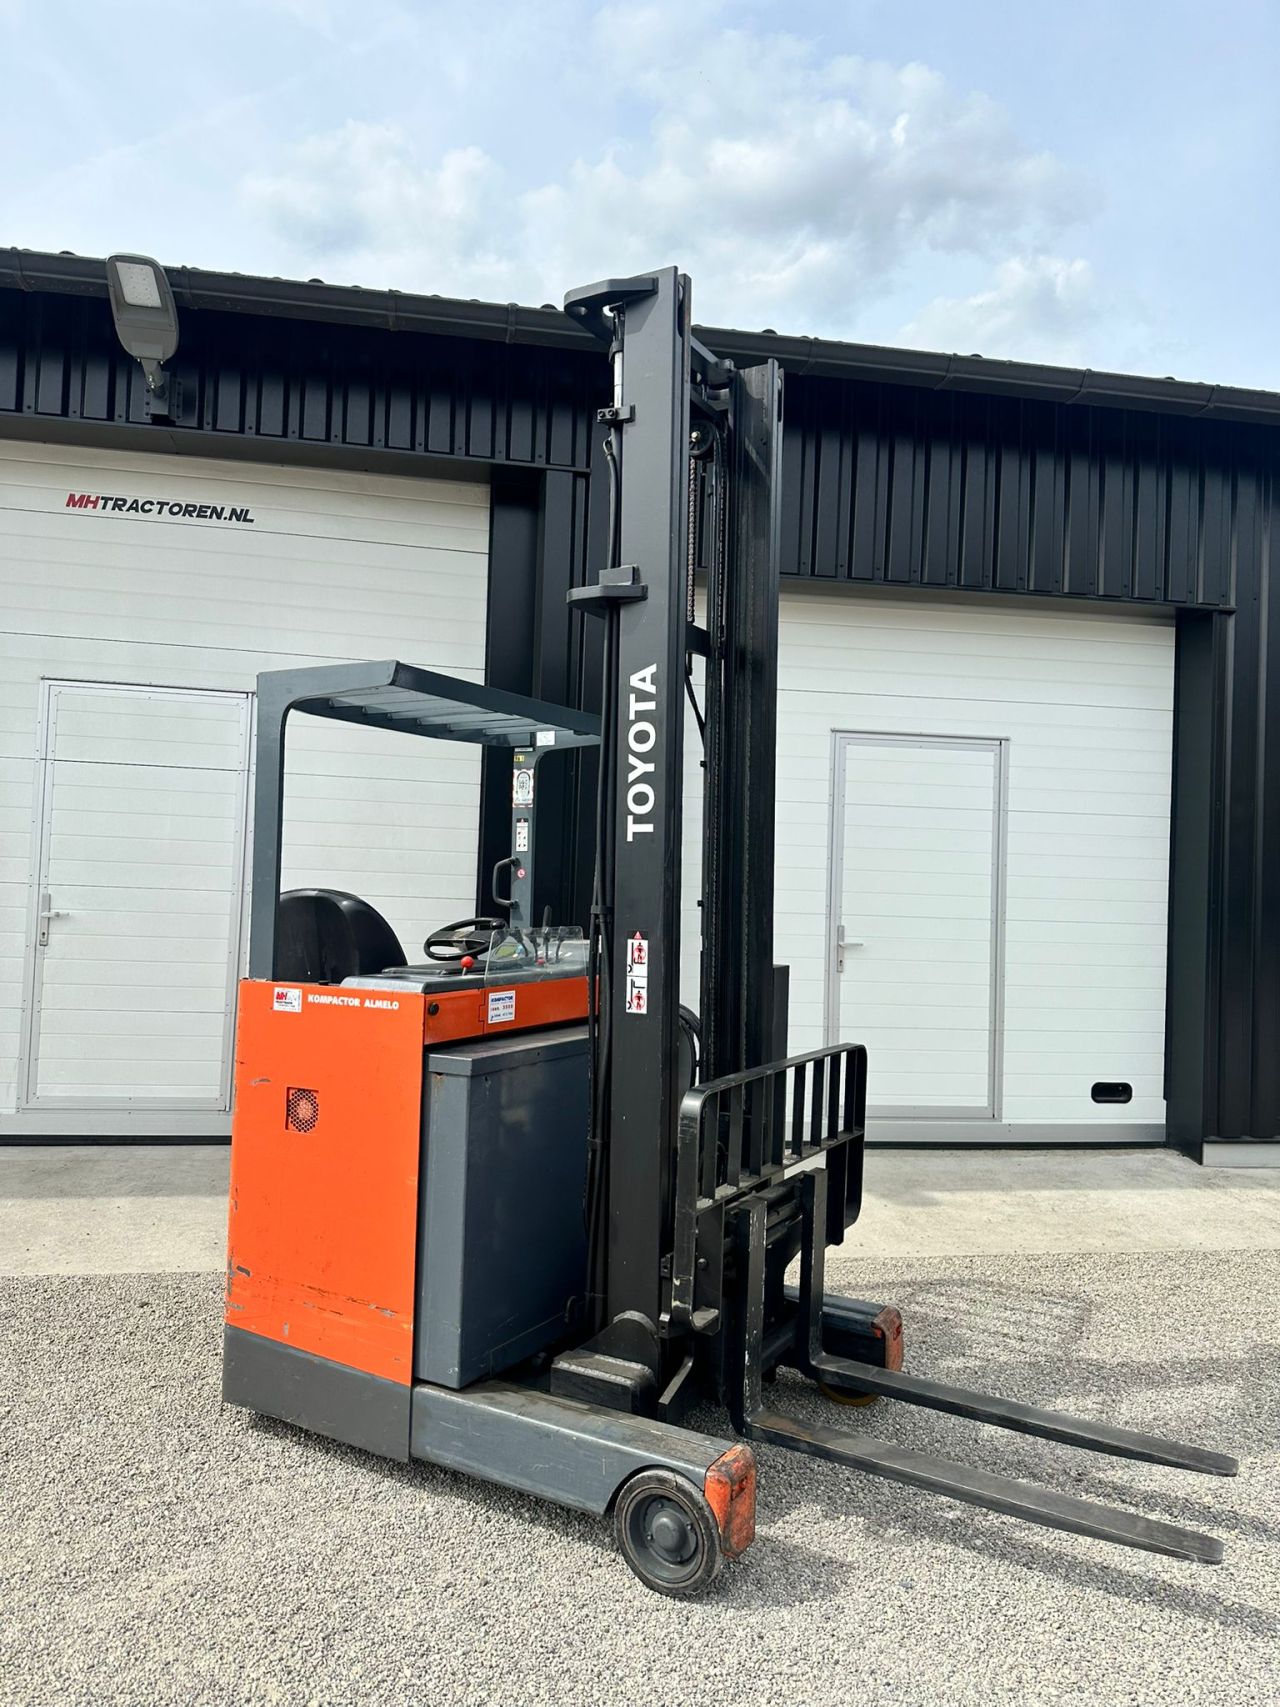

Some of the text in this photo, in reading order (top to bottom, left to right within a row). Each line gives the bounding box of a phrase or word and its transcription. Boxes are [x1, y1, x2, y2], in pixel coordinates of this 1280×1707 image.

[65, 493, 255, 523] MHTRACTOREN.NL
[626, 663, 657, 842] TOYOTA
[307, 994, 400, 1010] KOMPACTOR ALMELO
